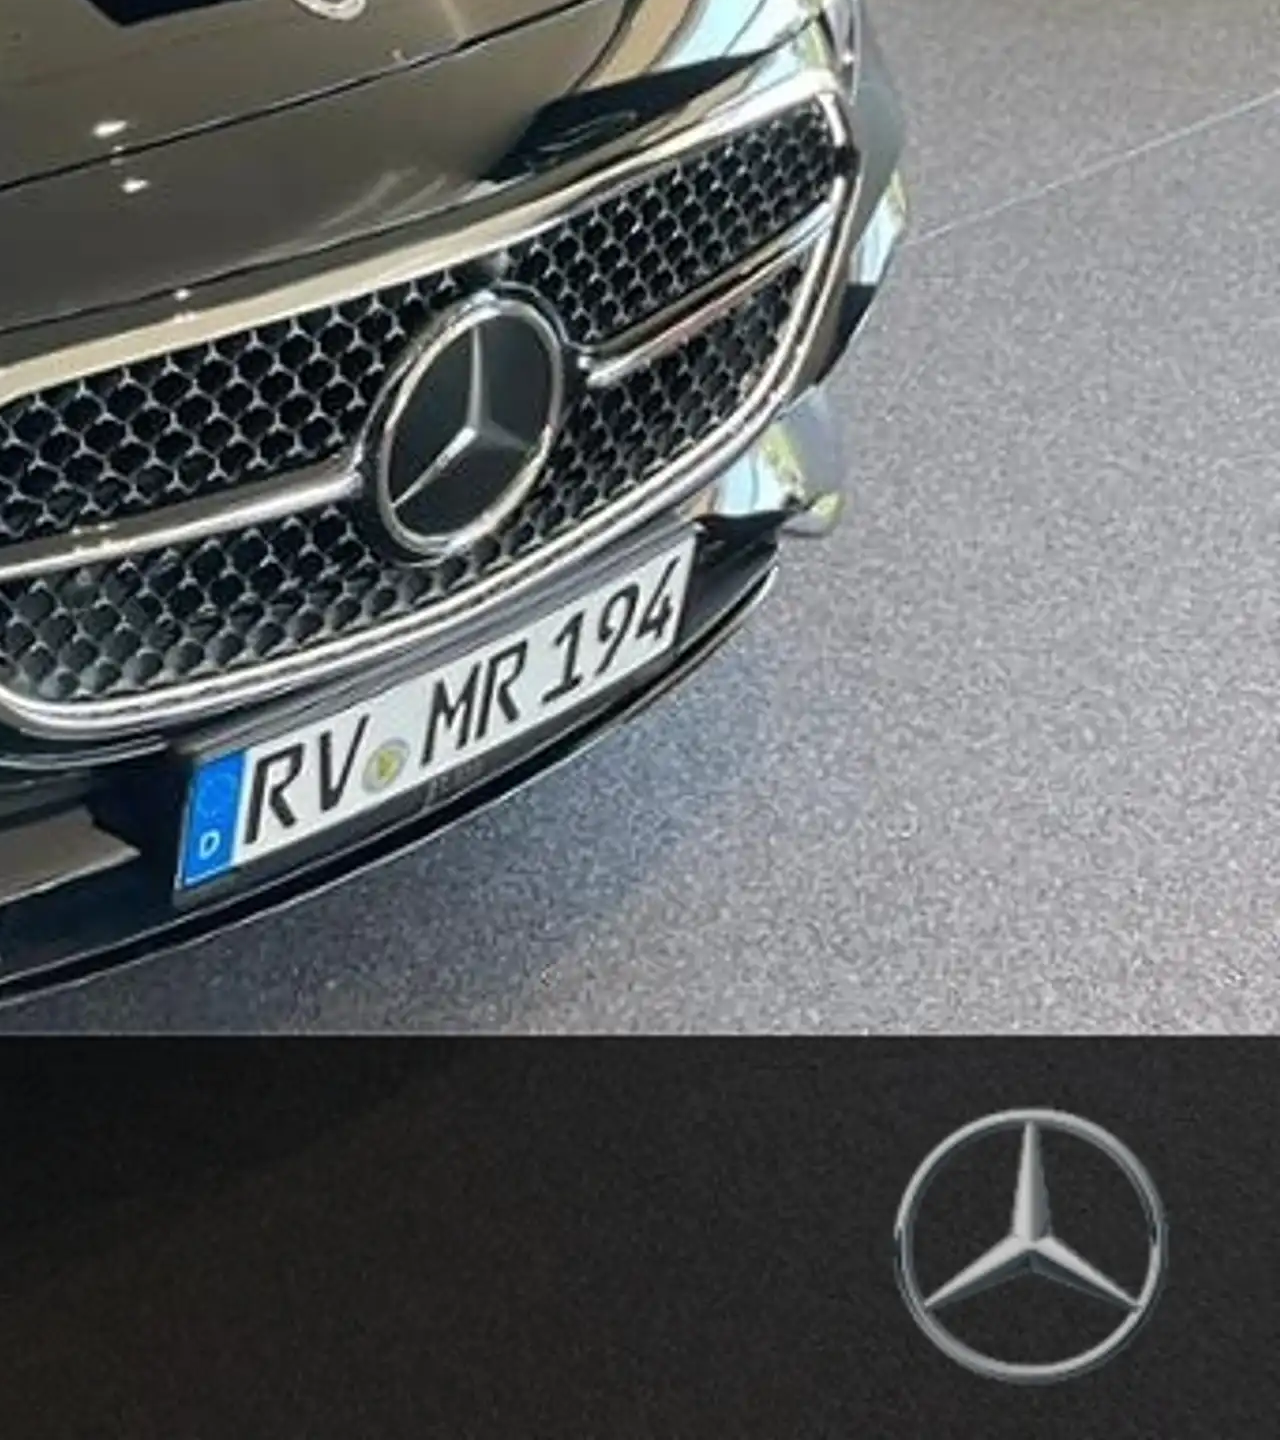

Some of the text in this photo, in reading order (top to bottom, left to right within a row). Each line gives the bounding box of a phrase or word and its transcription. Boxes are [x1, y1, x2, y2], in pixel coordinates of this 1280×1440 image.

[243, 554, 681, 846] RV MR 194
[198, 829, 220, 858] D
